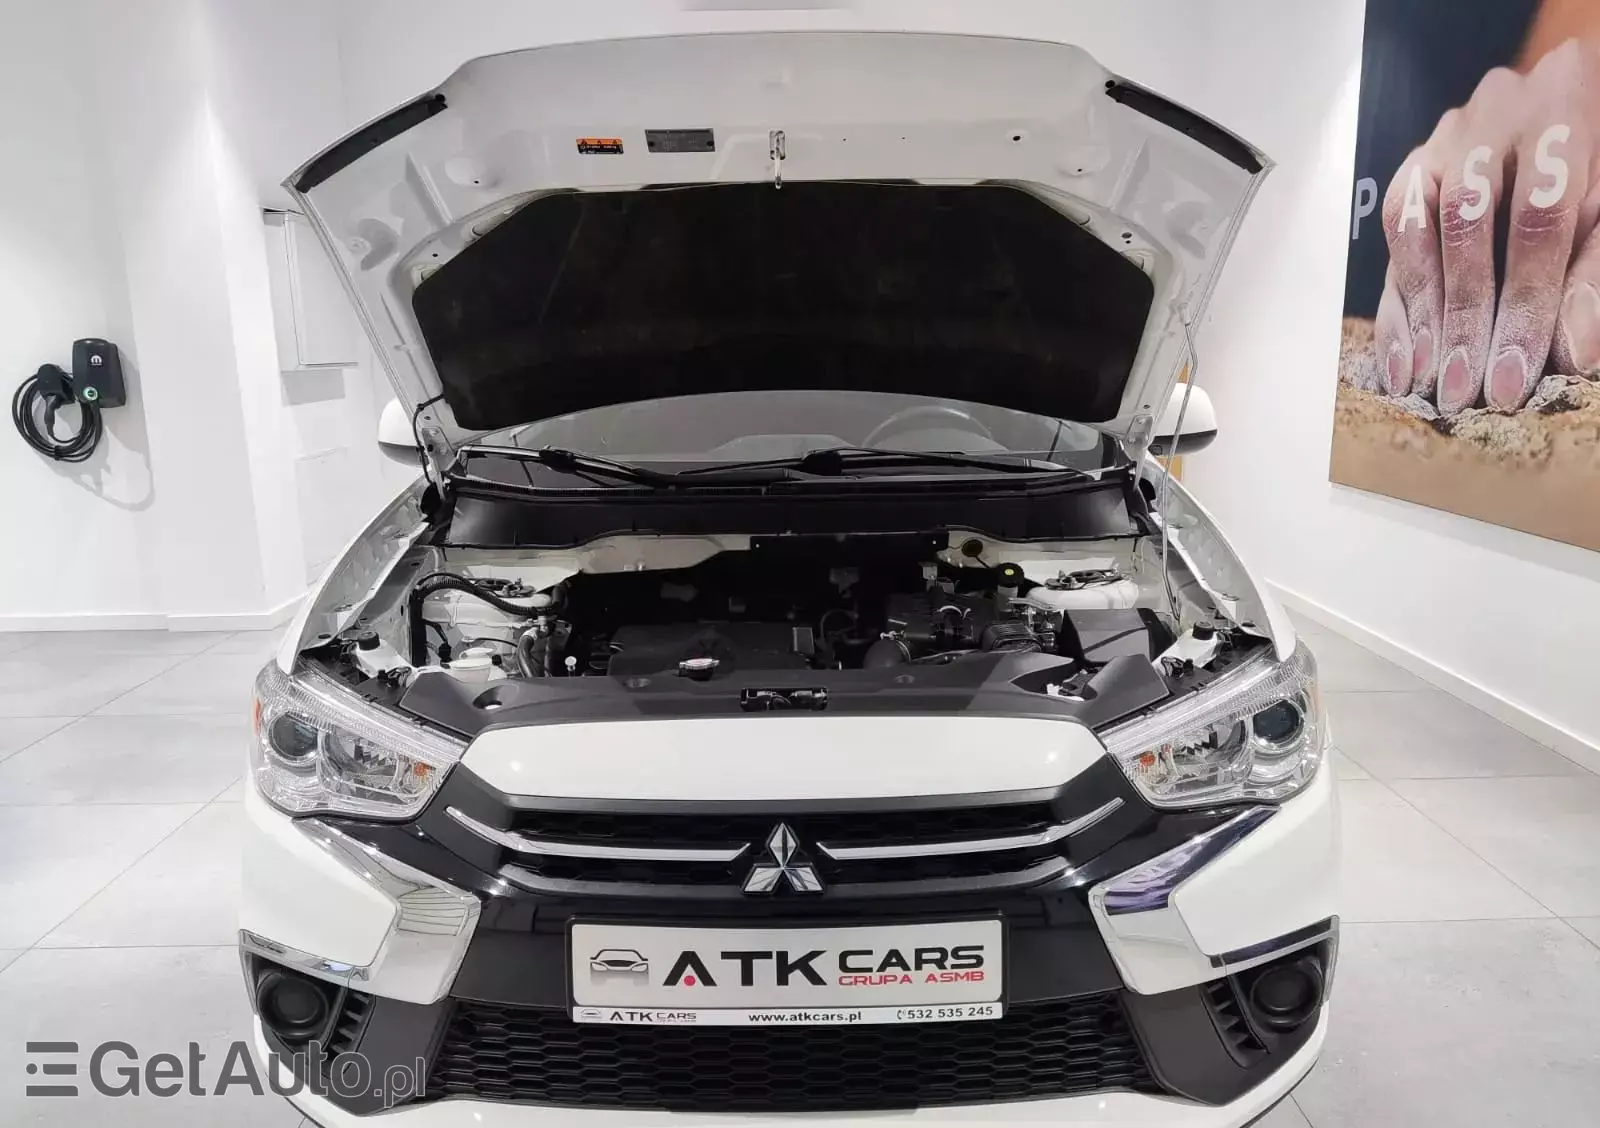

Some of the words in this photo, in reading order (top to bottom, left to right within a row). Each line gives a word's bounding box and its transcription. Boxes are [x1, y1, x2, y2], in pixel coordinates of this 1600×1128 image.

[1352, 124, 1571, 240] PASS
[662, 950, 828, 986] ATK
[838, 945, 985, 973] CARS
[838, 974, 913, 987] GRUPA
[924, 971, 985, 984] ASMB
[610, 1011, 653, 1022] ATK
[656, 1012, 697, 1020] CARS
[749, 1011, 862, 1023] www.atkcars.pl
[907, 1009, 933, 1019] 532
[937, 1008, 963, 1018] 535
[968, 1006, 993, 1017] 245
